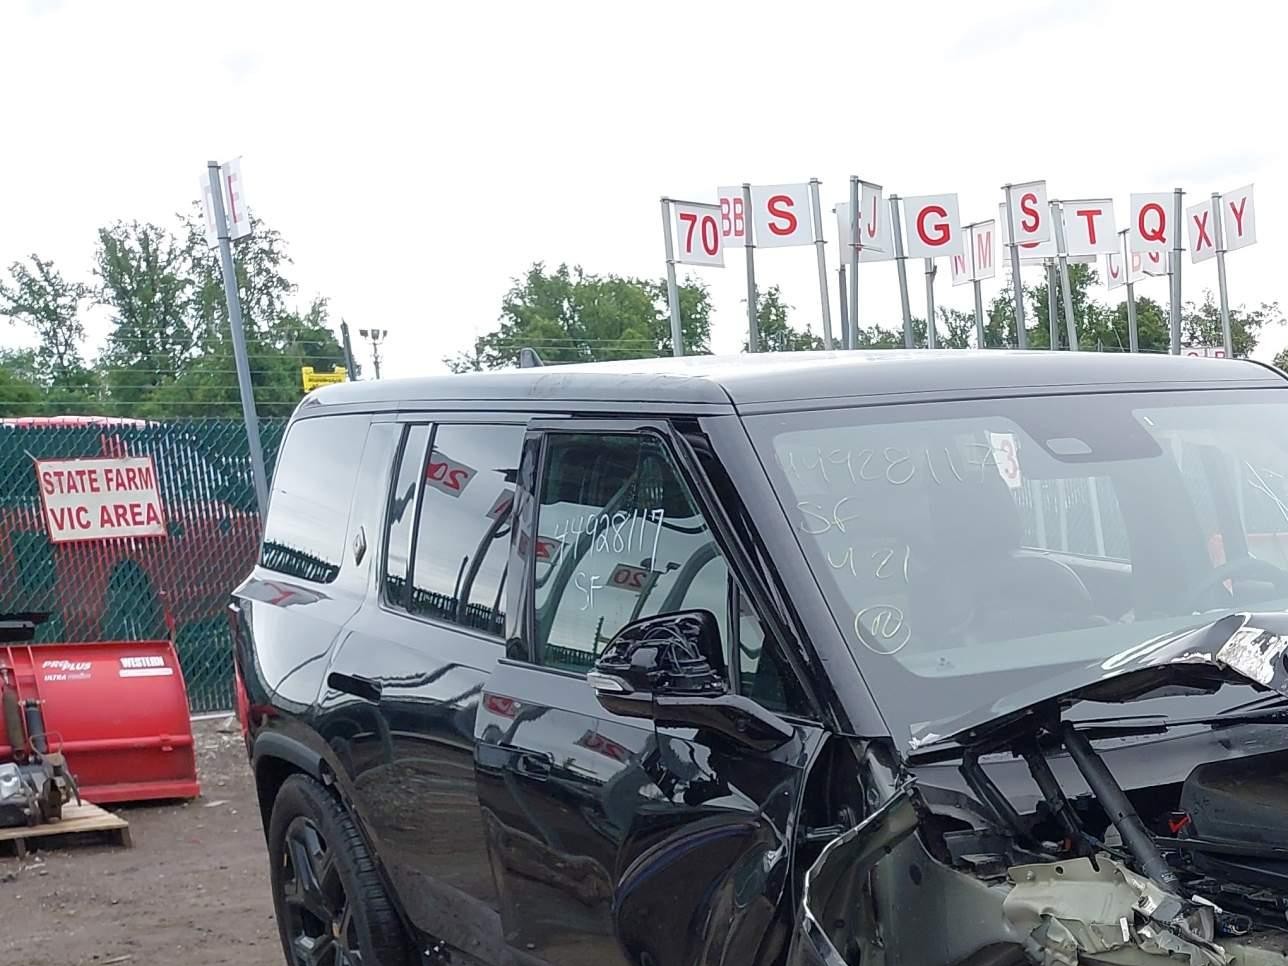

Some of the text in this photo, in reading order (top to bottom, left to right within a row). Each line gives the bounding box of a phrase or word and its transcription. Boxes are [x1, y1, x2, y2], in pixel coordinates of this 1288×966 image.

[767, 195, 798, 236] S
[867, 196, 877, 238] J
[916, 205, 951, 247] G
[1020, 193, 1040, 233] S
[1076, 209, 1102, 245] T
[1138, 202, 1167, 244] Q
[1192, 210, 1213, 252] X
[1229, 196, 1247, 237] Y
[680, 213, 719, 256] 70
[977, 231, 992, 270] M
[42, 466, 154, 495] STATE FARM
[49, 502, 160, 531] VIC AREA
[554, 508, 665, 574] 44928117
